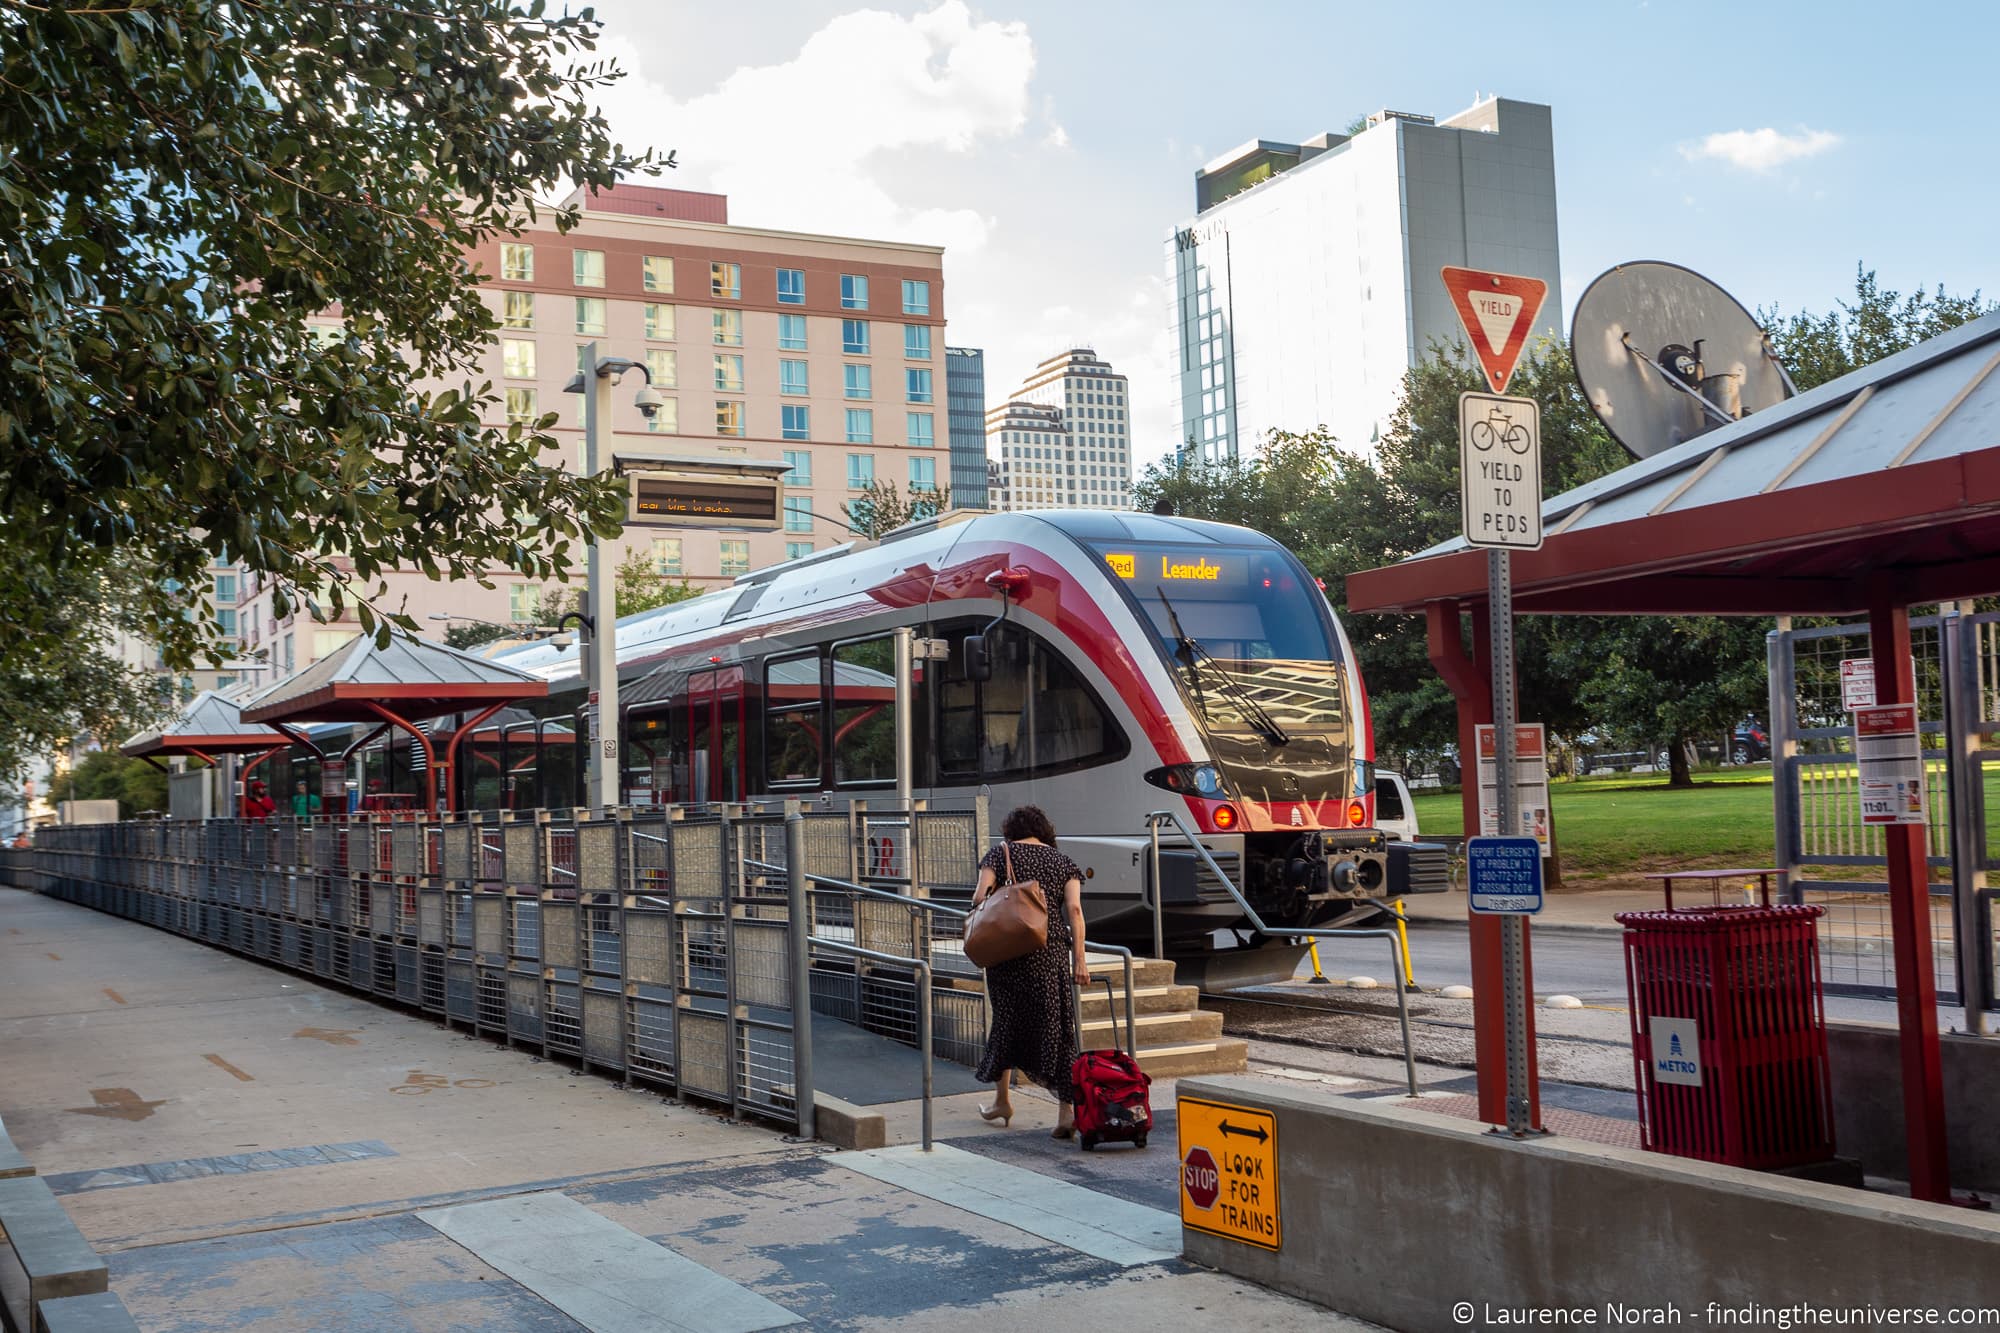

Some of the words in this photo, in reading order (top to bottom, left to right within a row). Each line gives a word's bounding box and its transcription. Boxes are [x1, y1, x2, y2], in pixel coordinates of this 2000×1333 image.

[1479, 299, 1512, 317] YIELD
[1480, 461, 1522, 482] YIELD
[1494, 488, 1512, 506] TO
[1483, 513, 1528, 534] PEDS
[1162, 555, 1221, 580] Leander
[1132, 852, 1140, 867] F
[1470, 847, 1495, 857] REPORT
[1496, 847, 1537, 858] EMERGENCY
[1476, 859, 1486, 869] OR
[1488, 859, 1521, 870] PROBLEM
[1522, 859, 1532, 870] TO
[1477, 883, 1511, 893] CROSSING
[1658, 1060, 1697, 1074] METRO
[1224, 1151, 1265, 1180] LOOK
[1186, 1165, 1218, 1191] STOP
[1231, 1180, 1260, 1206] FOR
[1220, 1203, 1274, 1236] TRAINS
